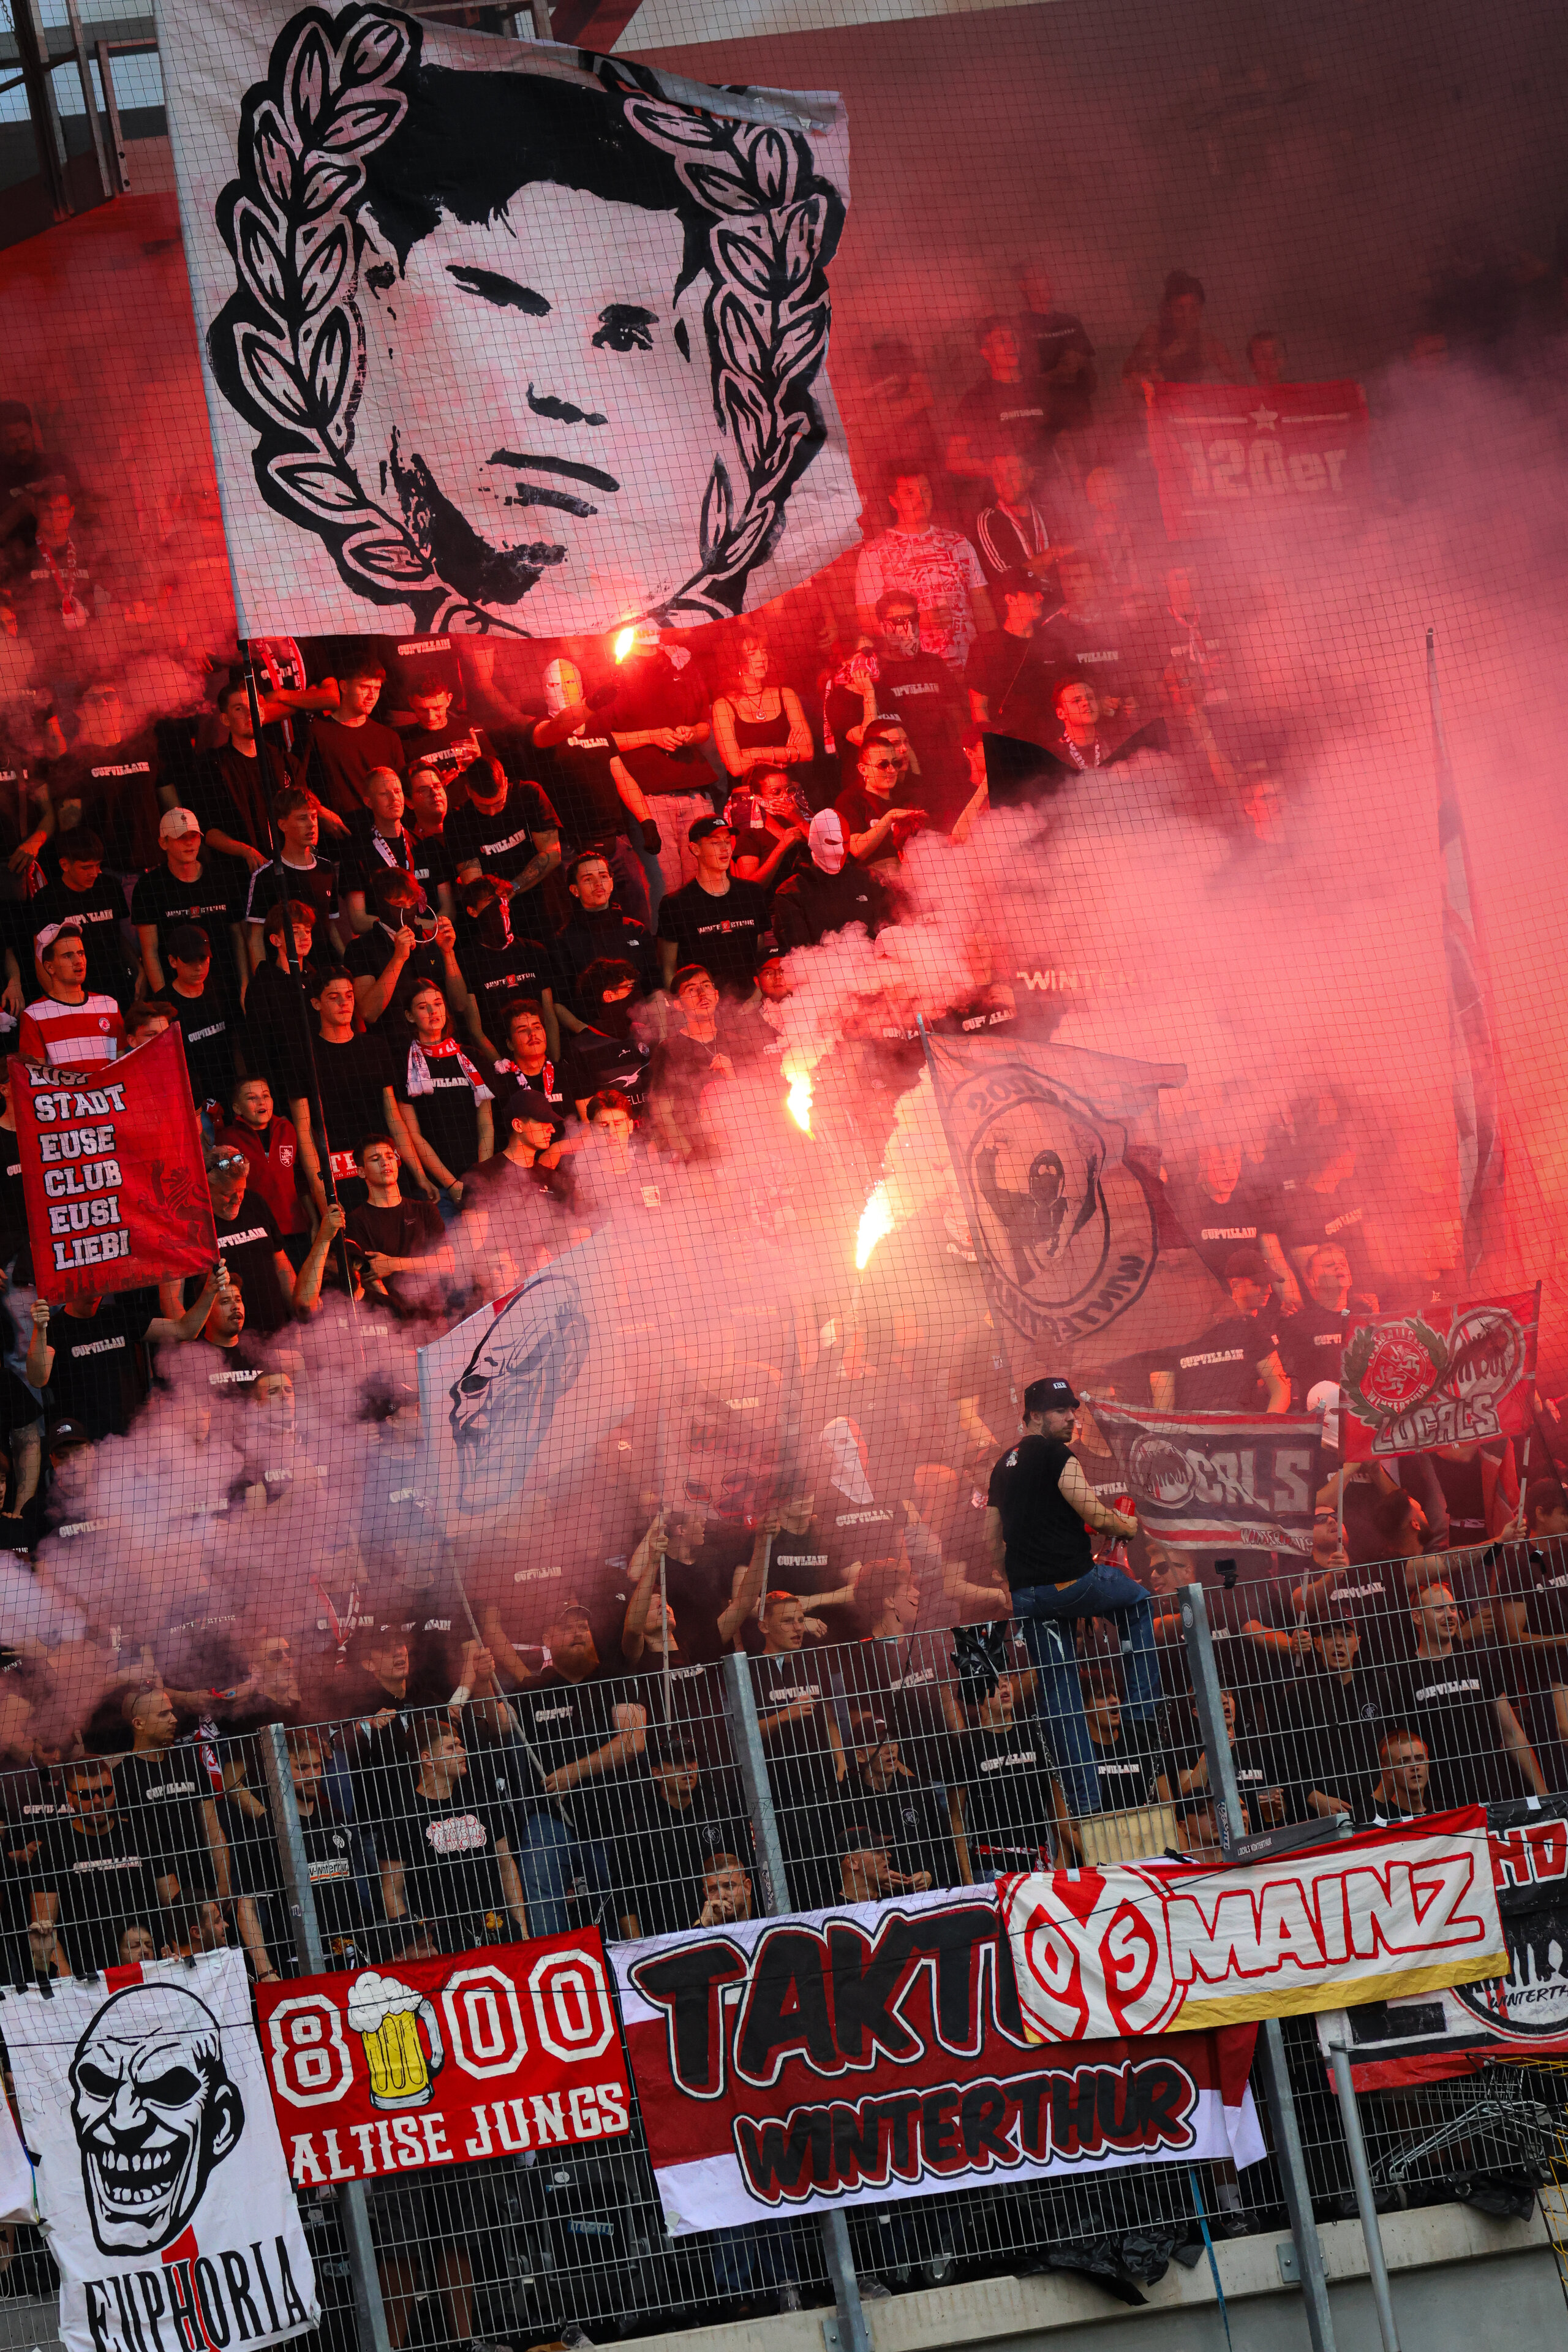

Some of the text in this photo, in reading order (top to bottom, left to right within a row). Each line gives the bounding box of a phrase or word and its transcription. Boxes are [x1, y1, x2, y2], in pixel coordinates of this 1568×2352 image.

[34, 1084, 126, 1123] STADT
[40, 1125, 115, 1163] EUSE
[43, 1159, 123, 1197] CLUB
[48, 1196, 121, 1235] EUSI
[53, 1229, 129, 1271] LIEBI
[1164, 1852, 1485, 1985] MAINZ
[290, 2082, 629, 2187] ALTISE JUNGS
[731, 2057, 1199, 2206] WINTERTHUR
[82, 2236, 307, 2352] EUPHORIA
